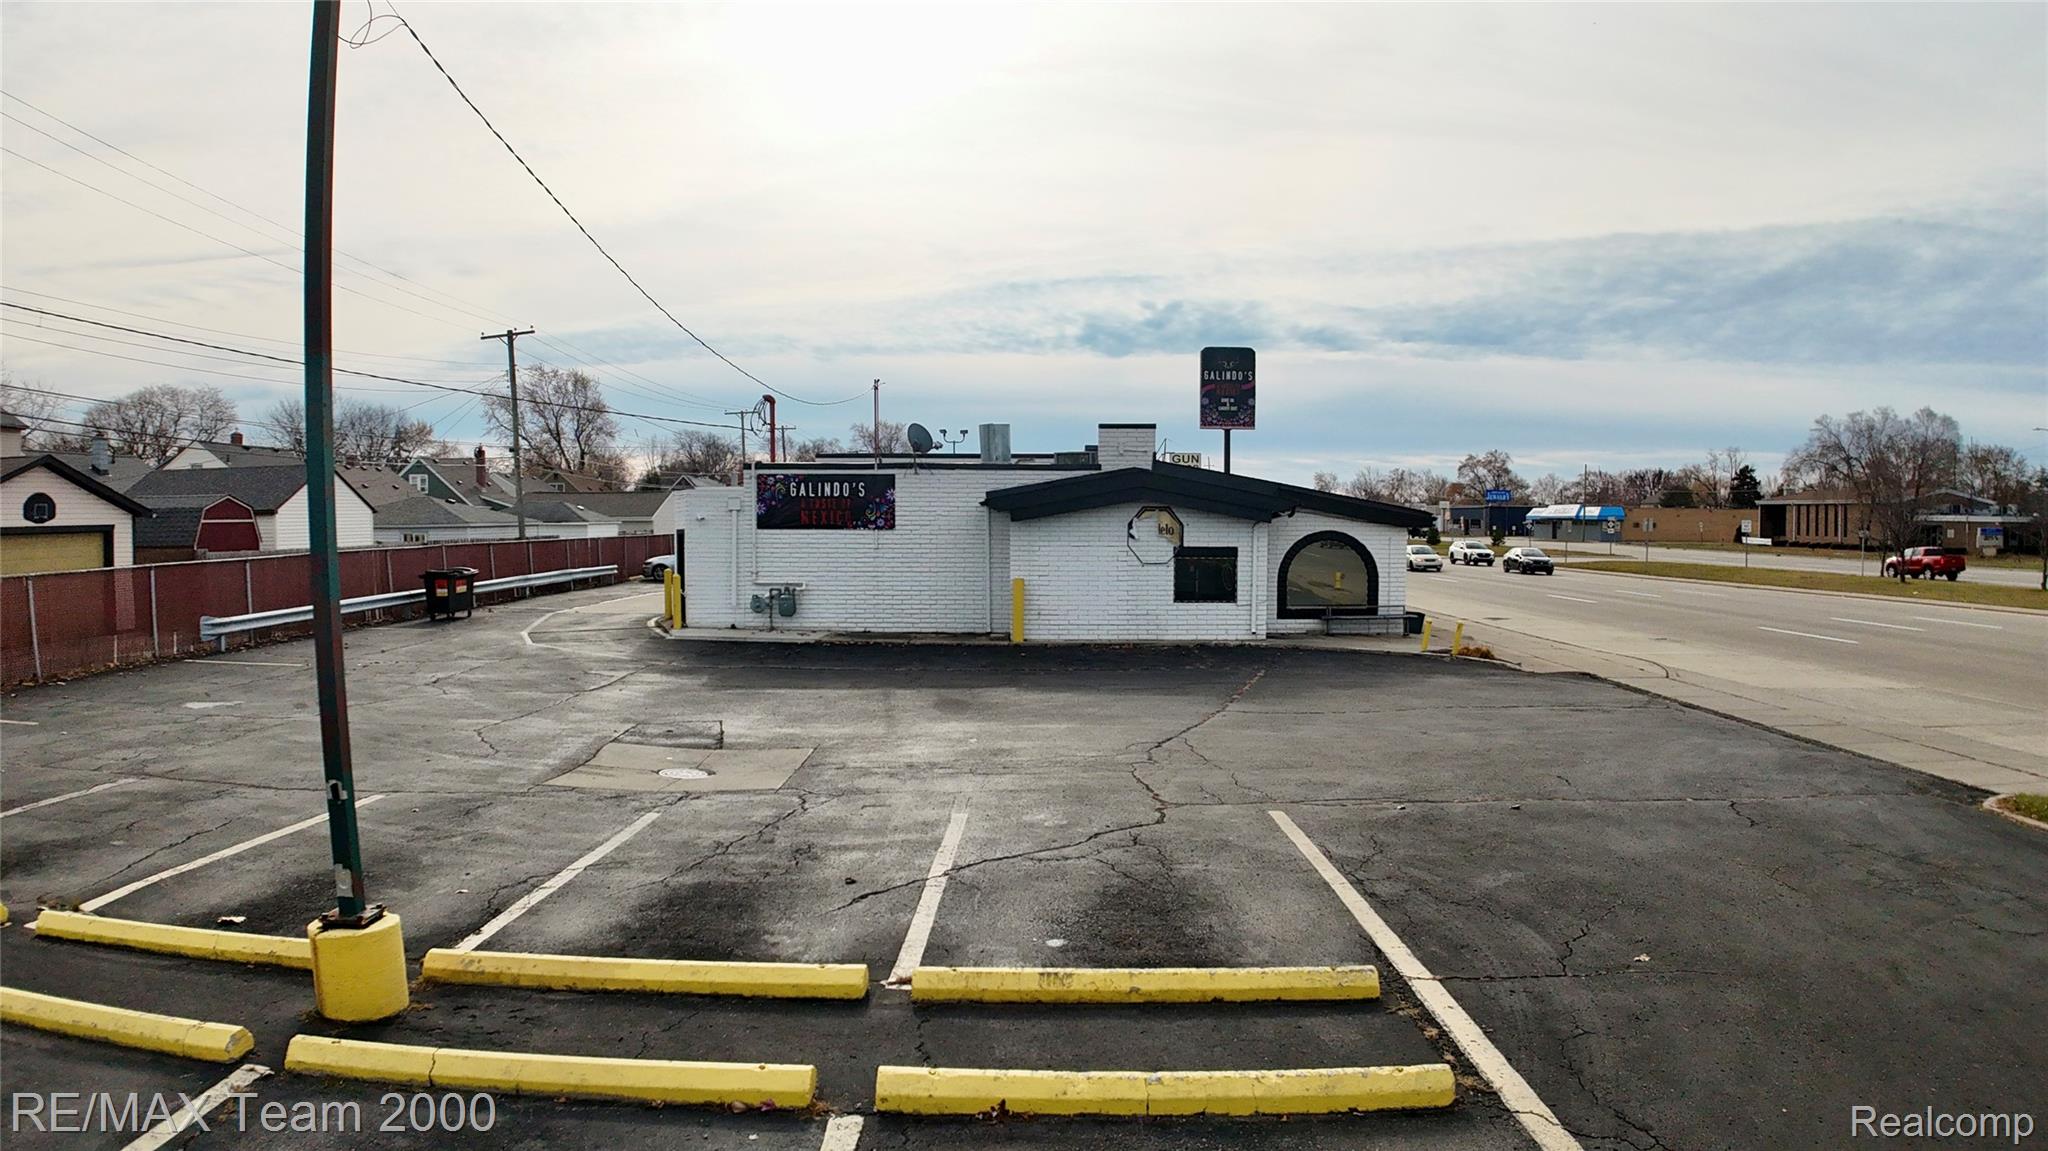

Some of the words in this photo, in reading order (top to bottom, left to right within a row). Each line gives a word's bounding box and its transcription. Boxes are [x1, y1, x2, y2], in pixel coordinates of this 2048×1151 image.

[1203, 370, 1253, 380] GALINDO'S
[1172, 454, 1199, 463] GUN
[789, 481, 865, 497] GALINDO'S
